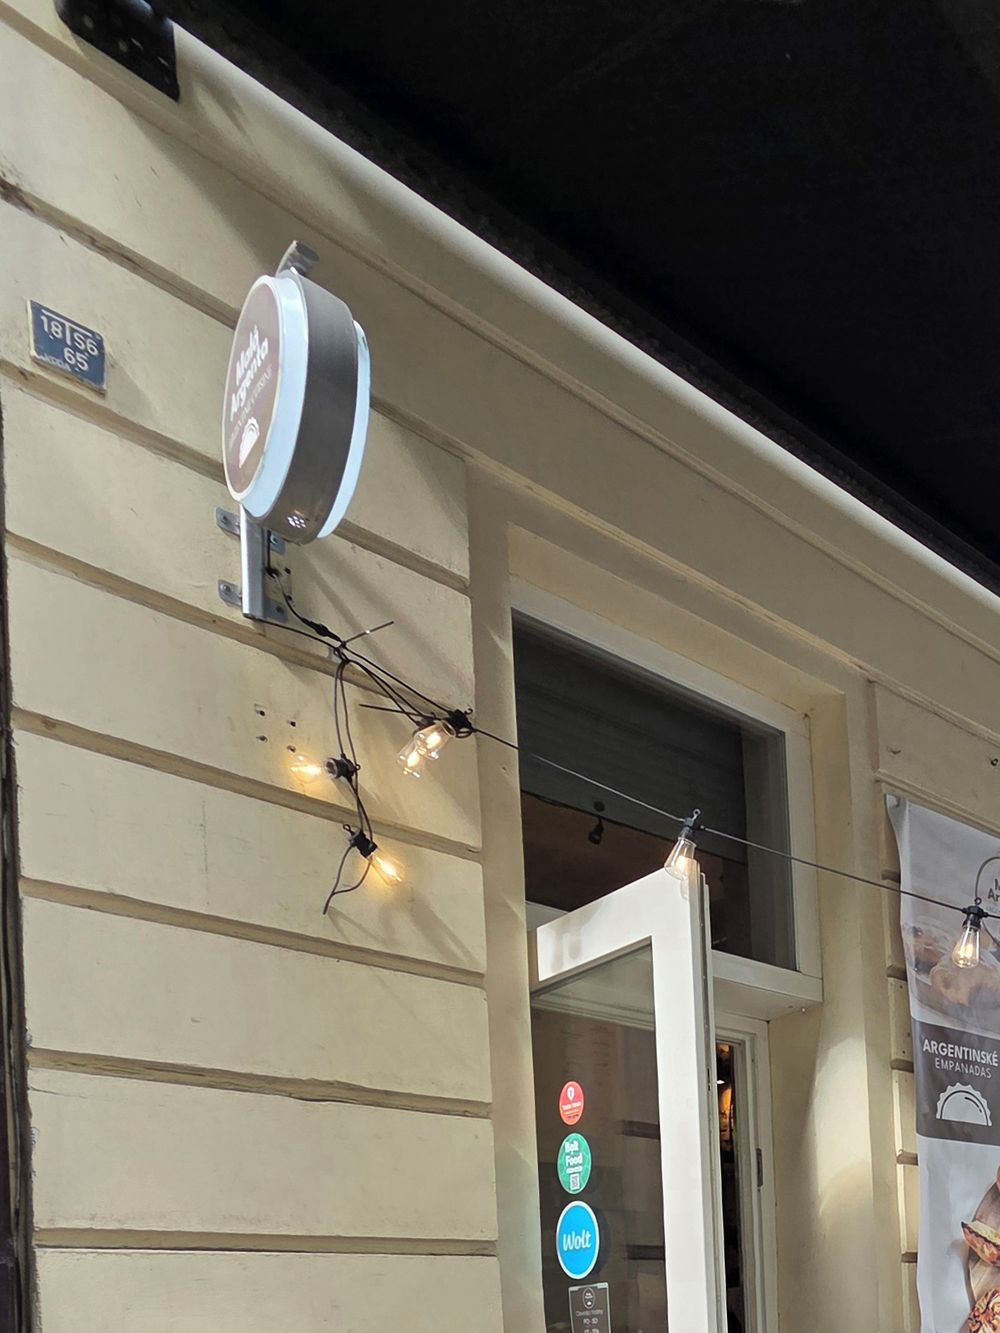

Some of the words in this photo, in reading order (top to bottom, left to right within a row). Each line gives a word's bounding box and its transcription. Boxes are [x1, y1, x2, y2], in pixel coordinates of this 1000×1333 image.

[231, 337, 269, 421] Argenta
[923, 1039, 999, 1067] ARGENTINSKÉ
[935, 1058, 992, 1079] EMPANADAS
[566, 1153, 583, 1166] Food
[563, 1230, 591, 1250] Wolt
